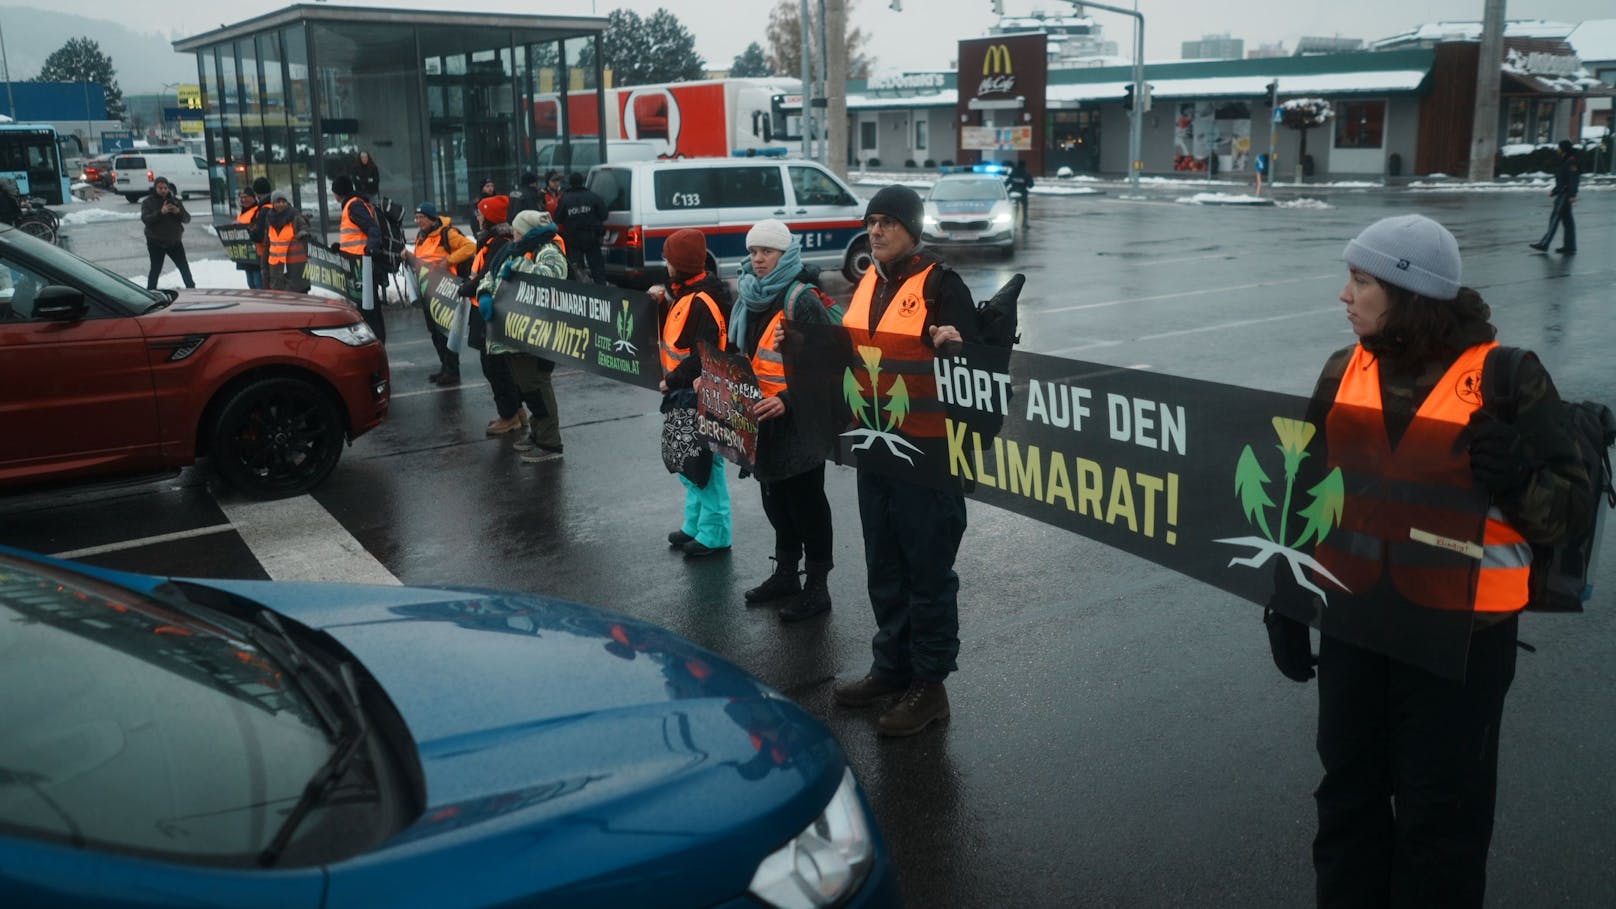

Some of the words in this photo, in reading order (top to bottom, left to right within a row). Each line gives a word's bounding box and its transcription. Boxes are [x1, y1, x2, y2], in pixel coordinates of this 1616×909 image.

[302, 263, 320, 282] NUR
[435, 276, 460, 300] HÖRT
[515, 280, 534, 305] WAR
[535, 286, 549, 309] DER
[550, 287, 587, 317] KLIMARAT
[589, 297, 611, 323] DENN
[504, 311, 531, 342] NUR
[527, 319, 553, 349] EIN
[551, 320, 590, 360] WITZ?
[594, 332, 612, 350] LETZTE
[597, 351, 640, 375] GENERATION.AT
[933, 356, 1011, 416] HÖRT
[1026, 378, 1092, 432] AUF
[1107, 392, 1186, 456] DEN
[945, 418, 1179, 546] KLIMARAT!
